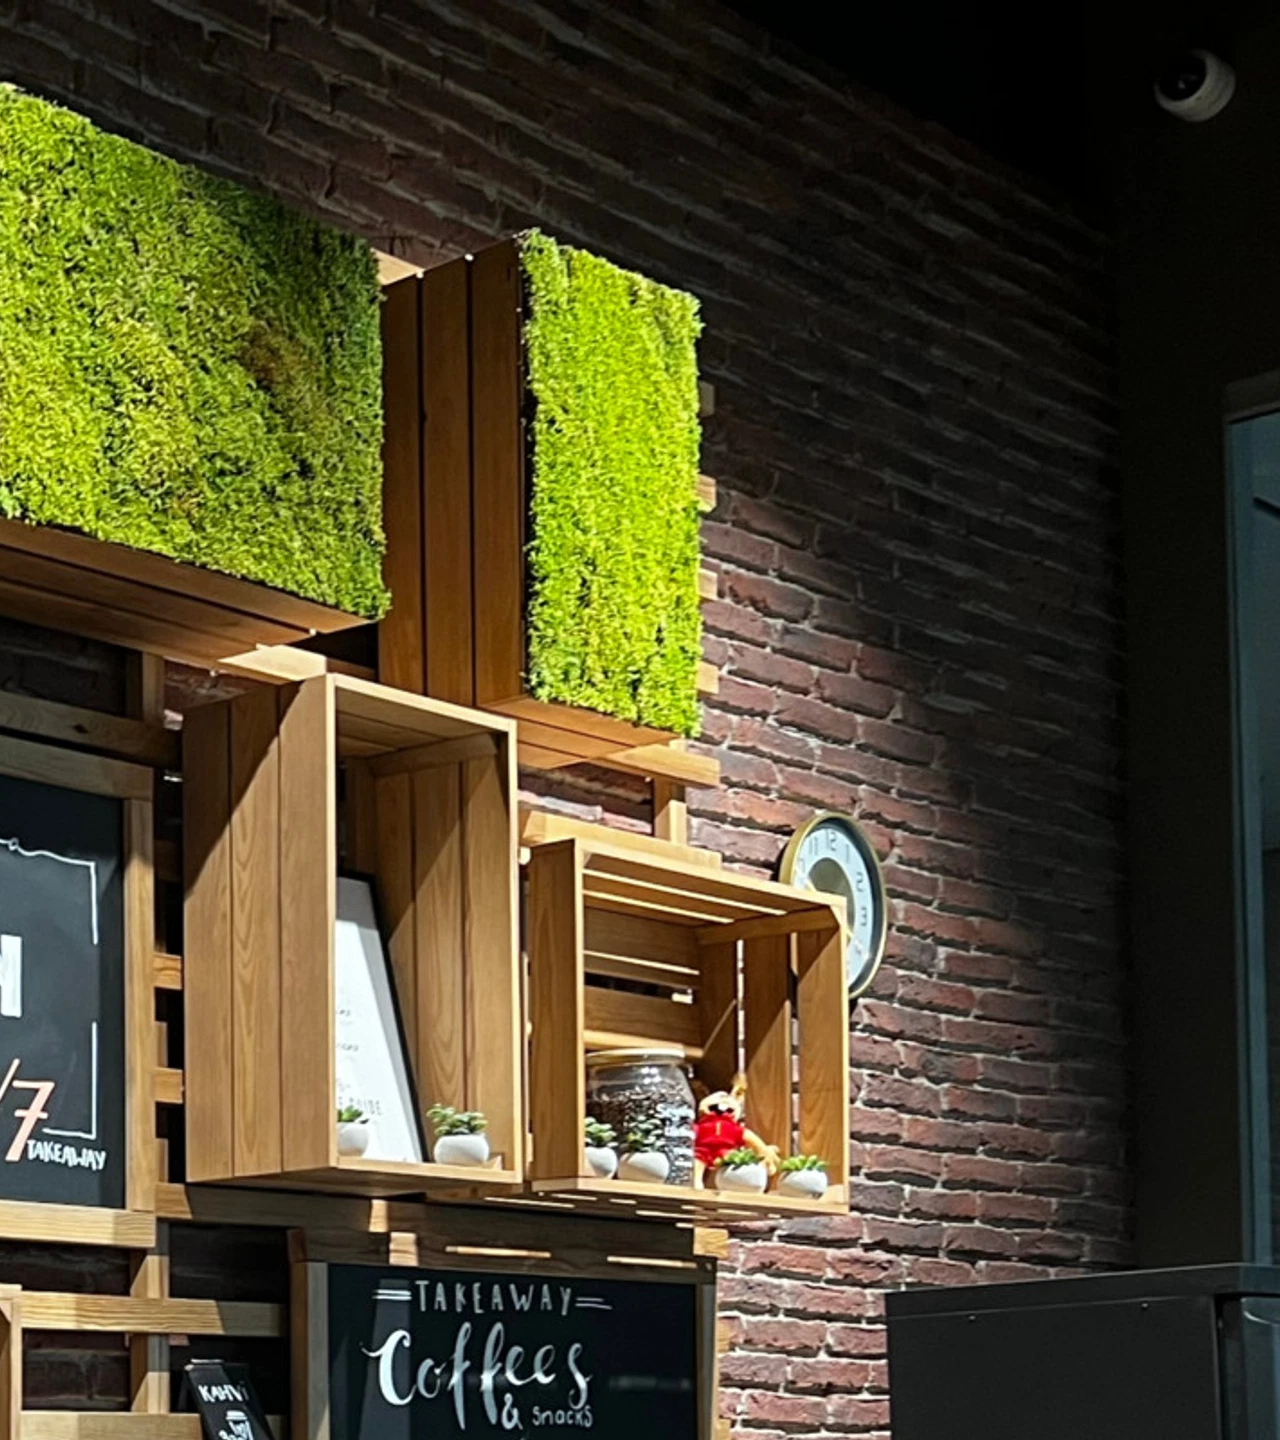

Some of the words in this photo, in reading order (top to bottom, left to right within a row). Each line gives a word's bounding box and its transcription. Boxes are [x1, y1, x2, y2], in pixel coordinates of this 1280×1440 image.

[27, 1139, 106, 1171] TAKEAWAY
[414, 1278, 573, 1316] TAKEAWAY
[359, 1321, 595, 1430] Coffees
